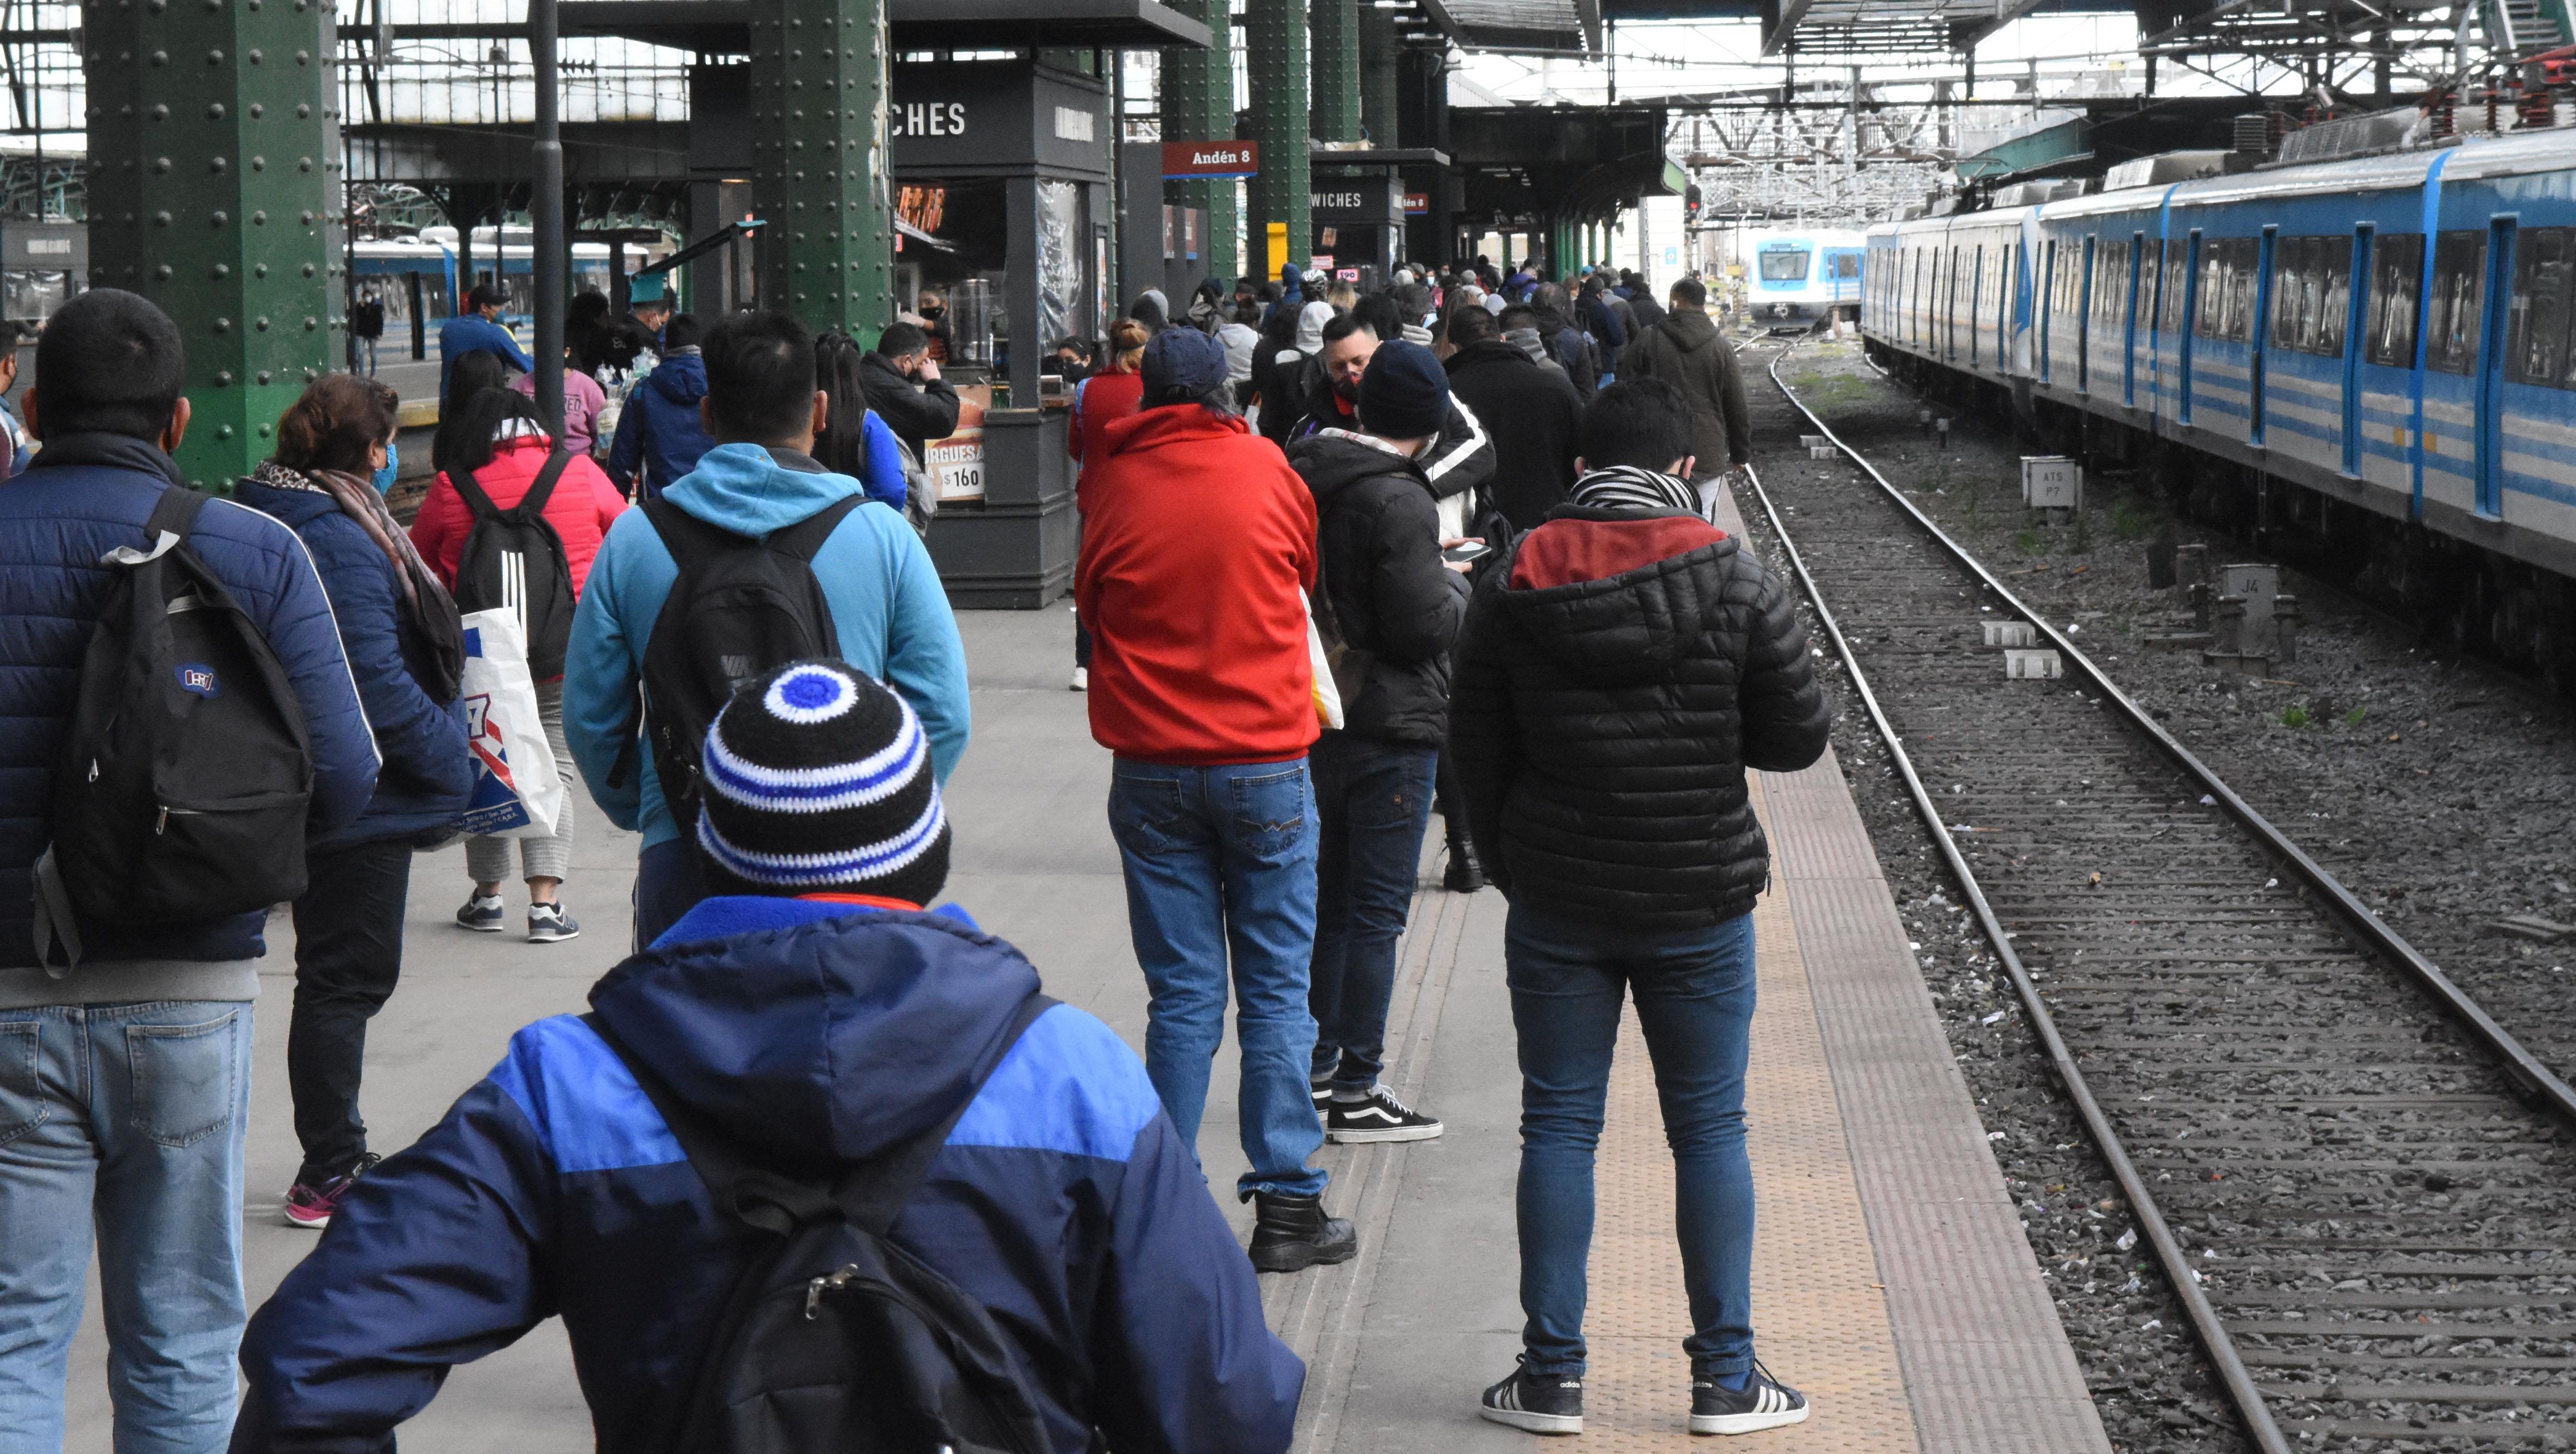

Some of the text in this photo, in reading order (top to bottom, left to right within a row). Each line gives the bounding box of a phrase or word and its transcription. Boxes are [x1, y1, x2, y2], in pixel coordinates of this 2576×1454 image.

[1192, 150, 1250, 164] Andén 8
[1310, 193, 1361, 207] WICHES
[1419, 198, 1424, 207] 8
[953, 468, 979, 487] 160
